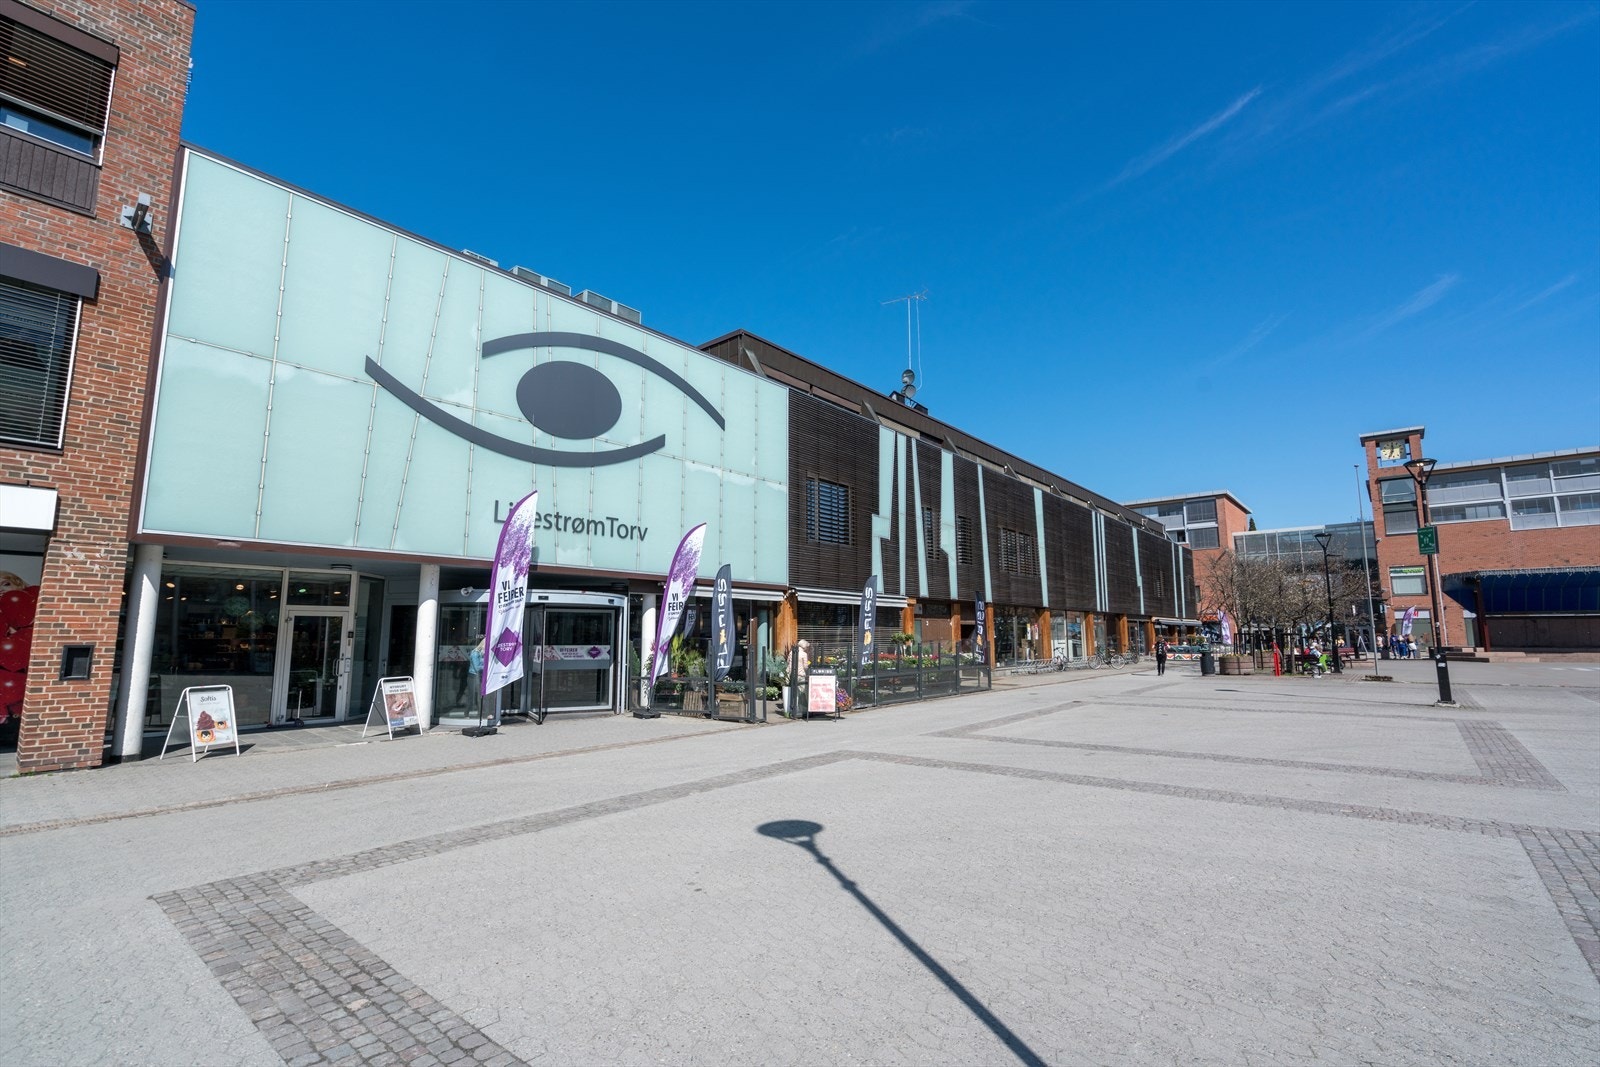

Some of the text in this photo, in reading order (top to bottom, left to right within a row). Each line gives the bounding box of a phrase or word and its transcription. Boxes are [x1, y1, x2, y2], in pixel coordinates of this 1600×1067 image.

[494, 499, 648, 541] LiestrømTorv
[502, 580, 511, 591] VI
[672, 593, 679, 601] VI
